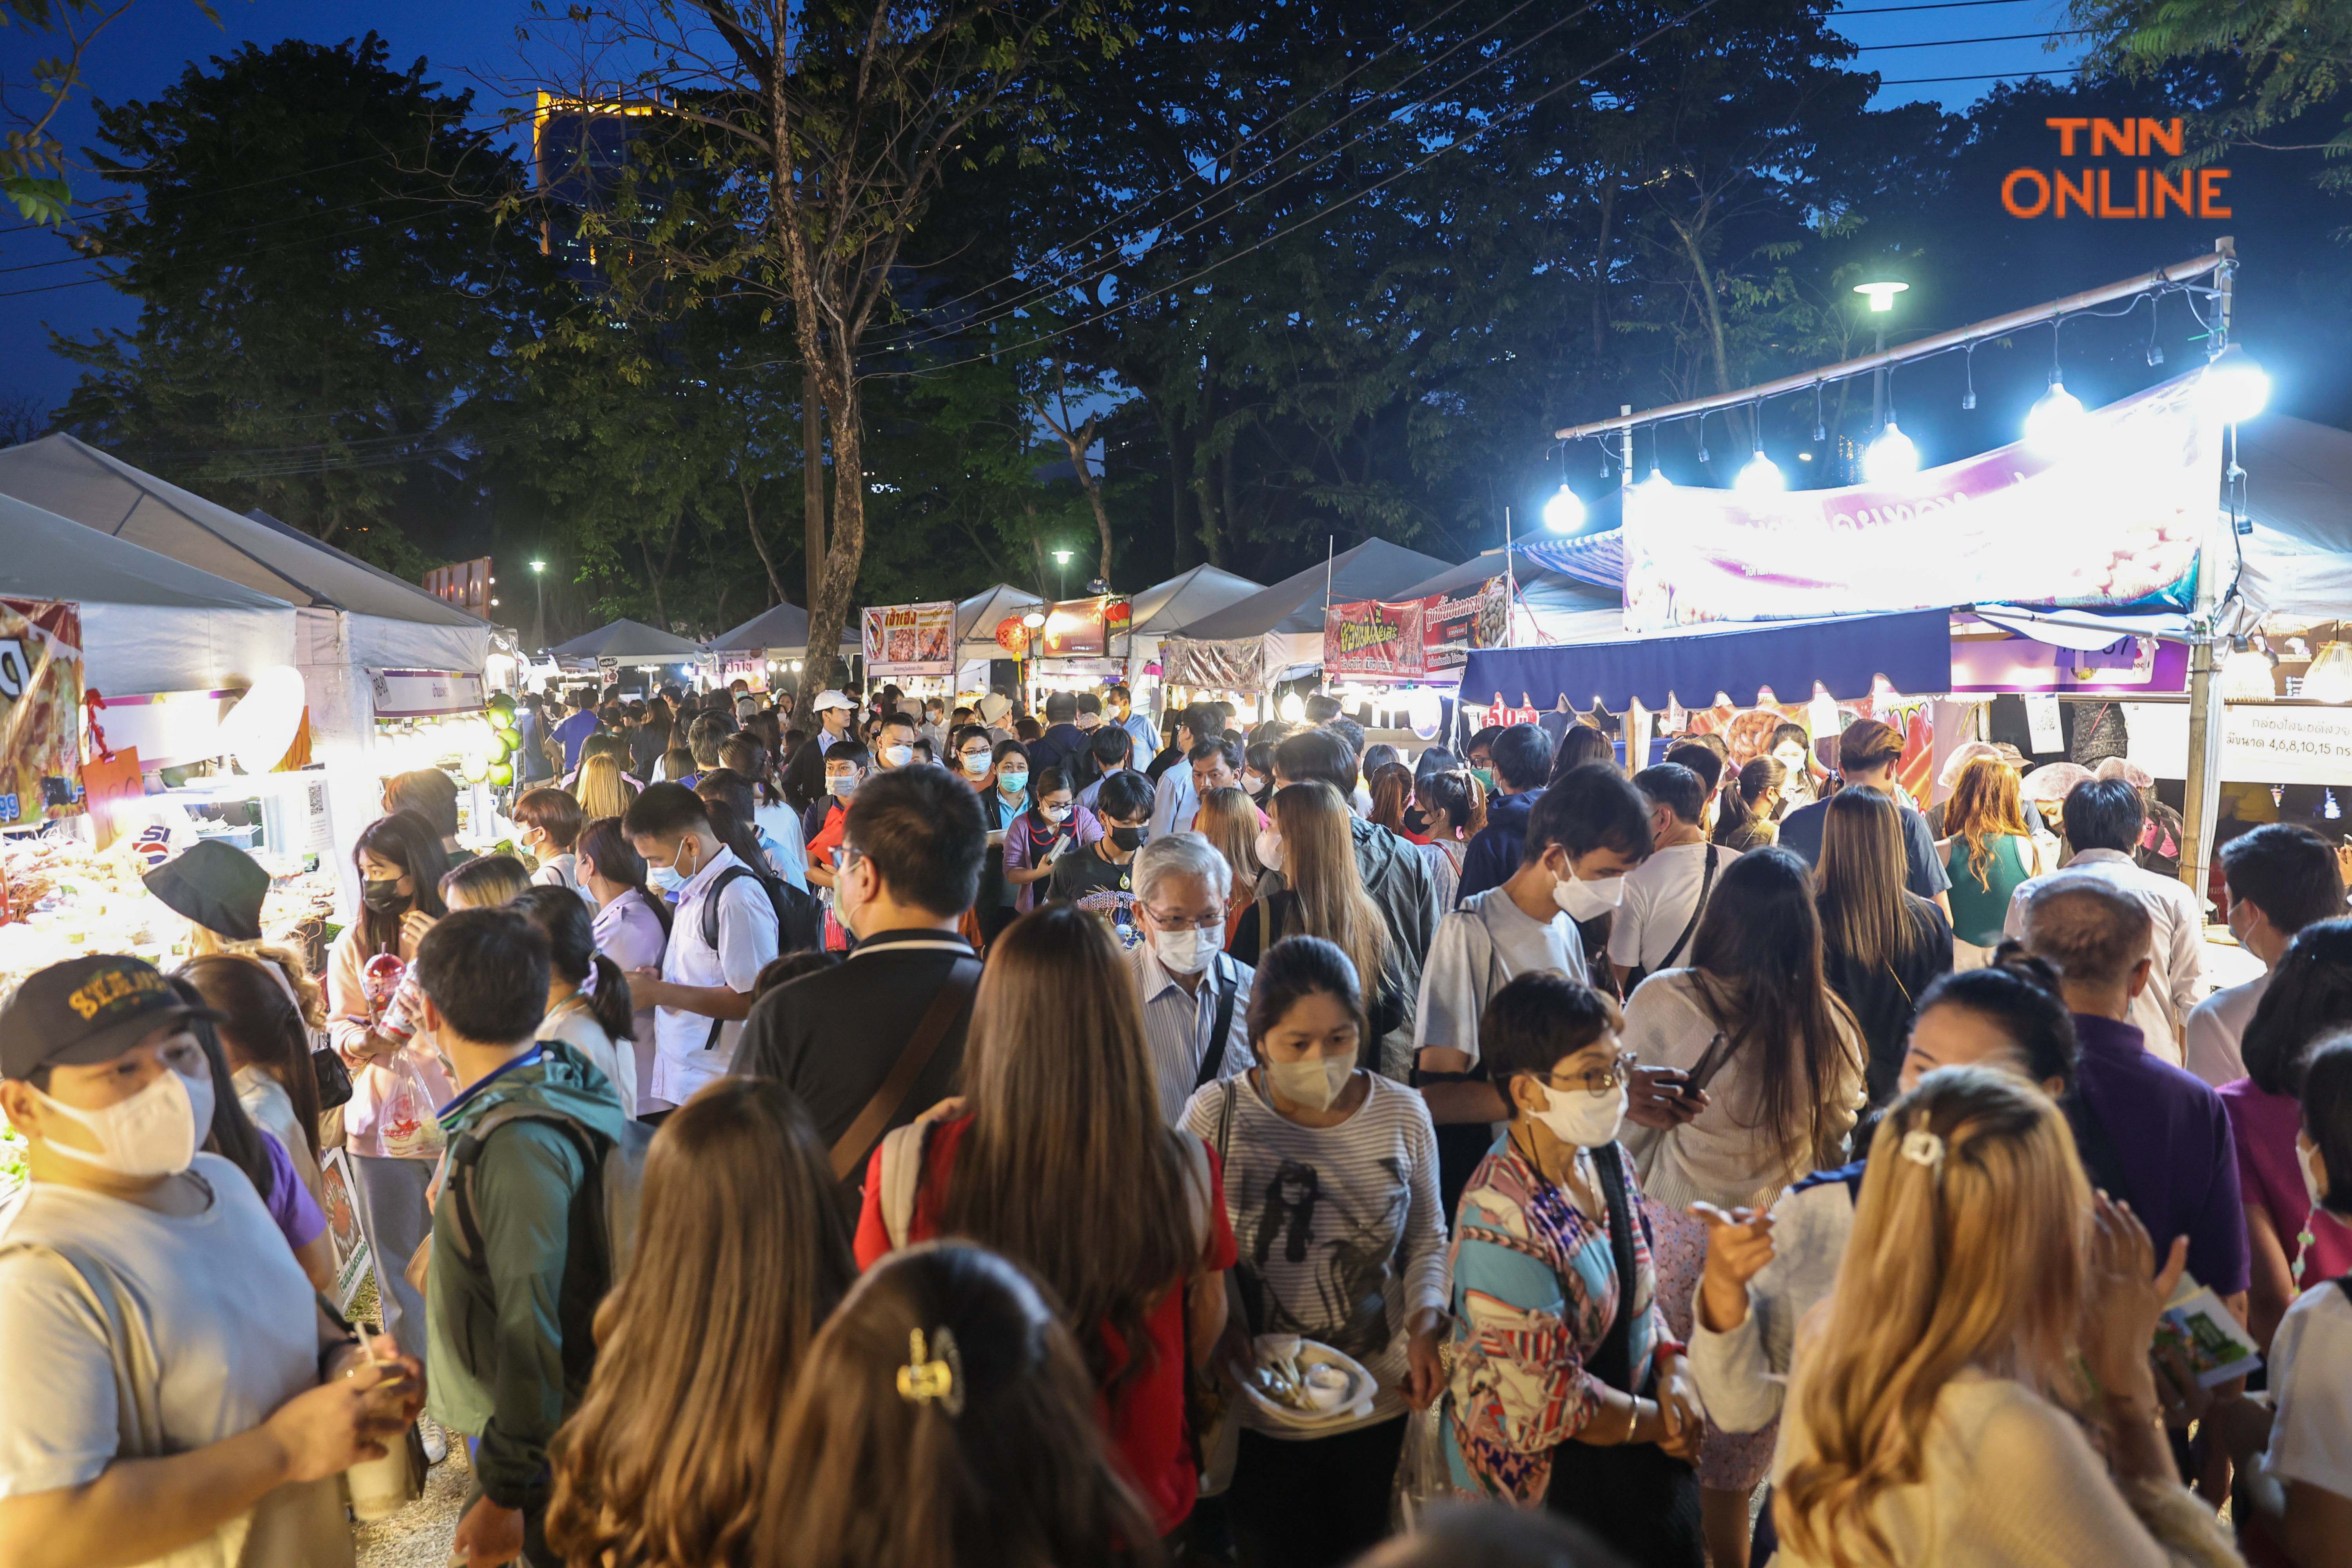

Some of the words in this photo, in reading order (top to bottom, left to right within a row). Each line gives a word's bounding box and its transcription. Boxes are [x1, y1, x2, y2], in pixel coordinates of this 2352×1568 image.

[1426, 593, 1485, 632] ลูกชิ้นปลากราย
[1460, 668, 1465, 681] R
[2227, 732, 2265, 748] มีขนาด
[2270, 739, 2331, 755] 4,6,8,10,15
